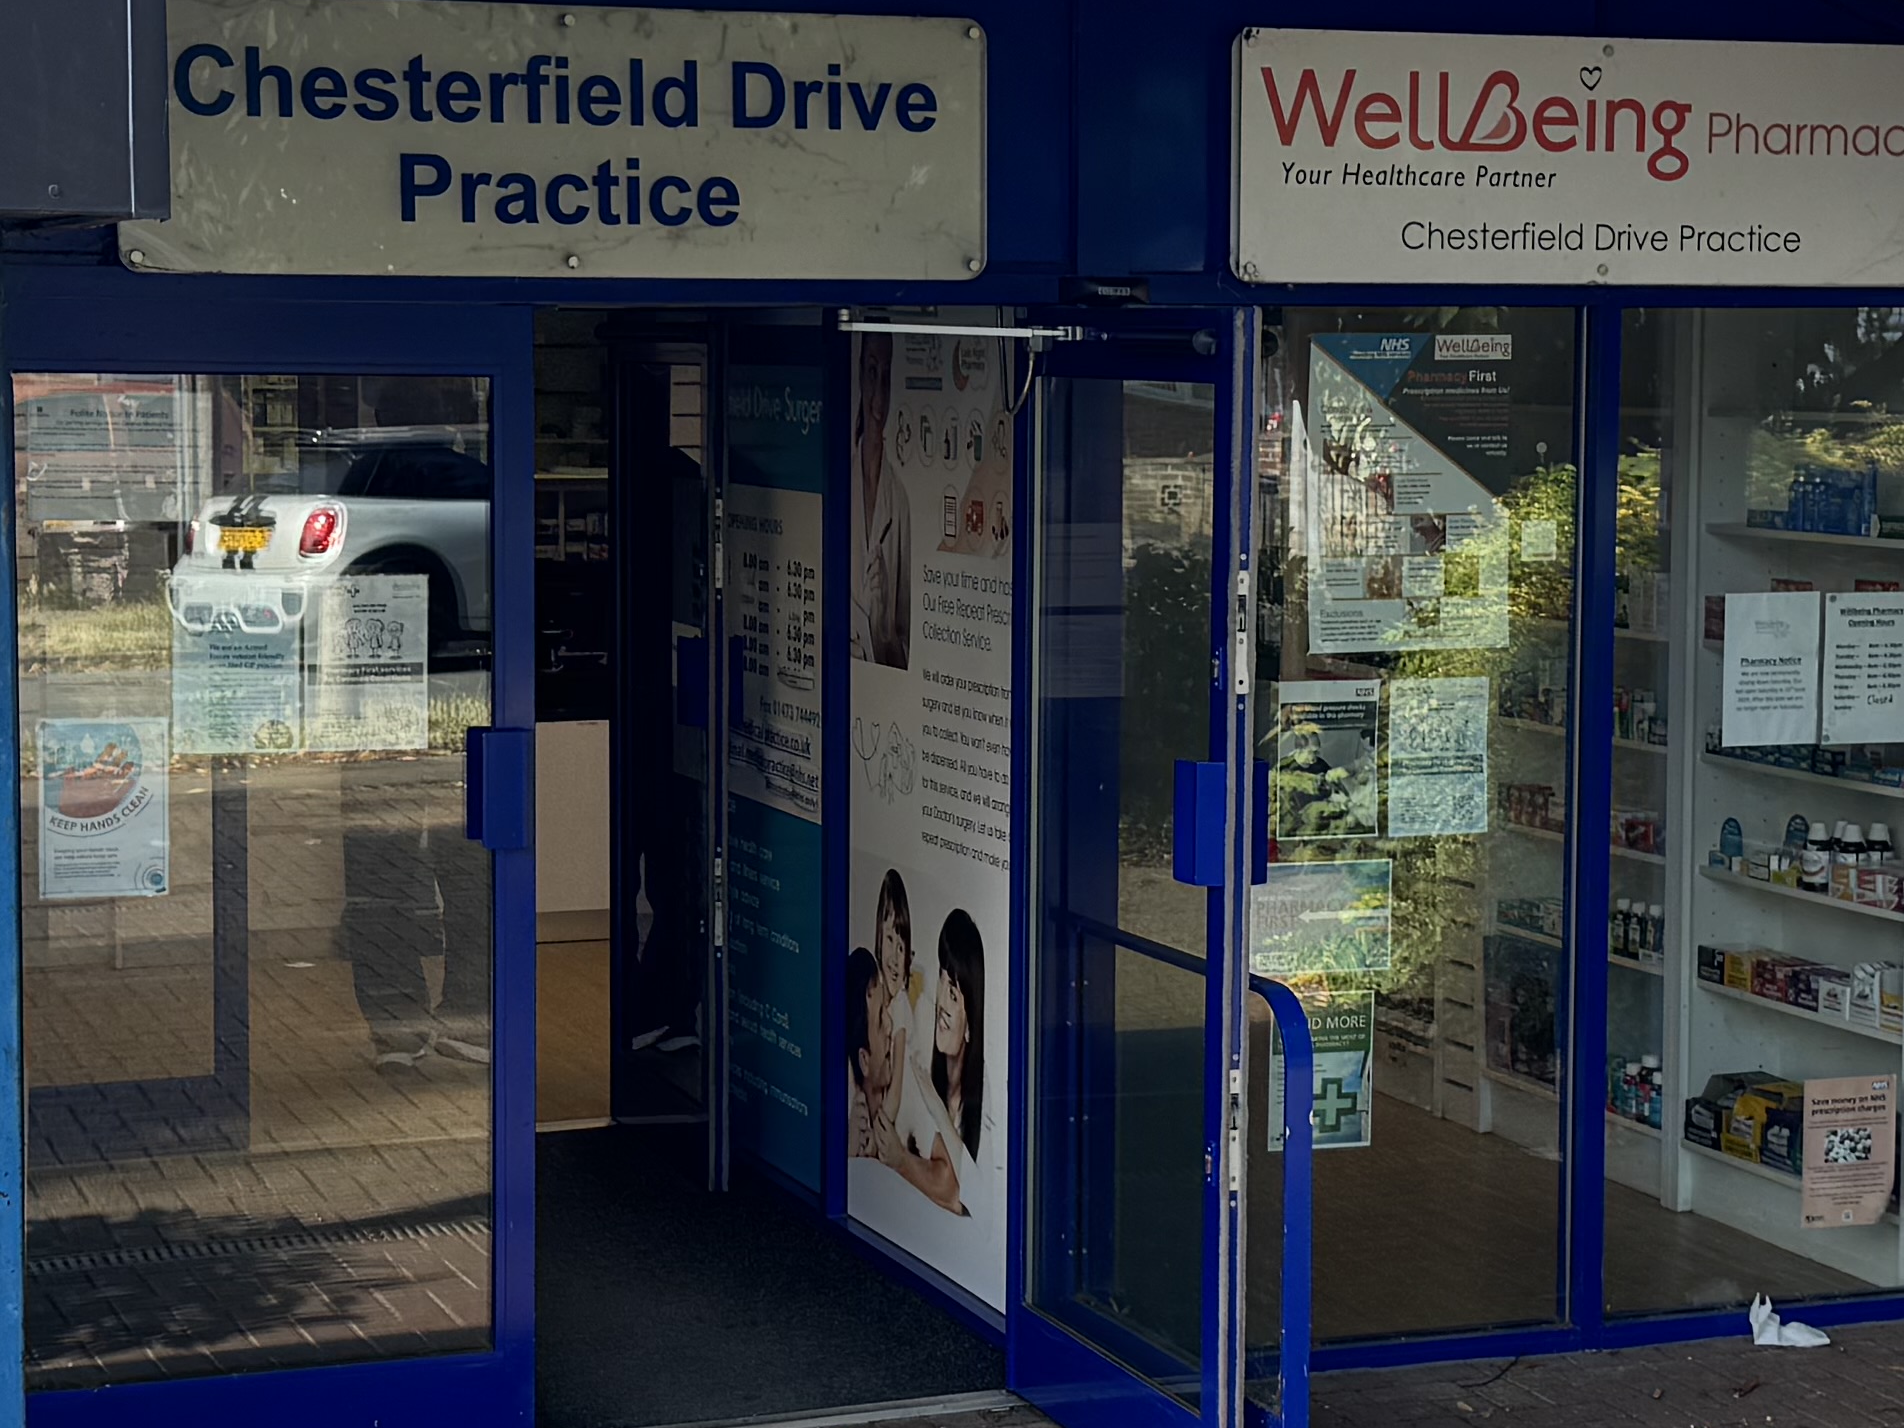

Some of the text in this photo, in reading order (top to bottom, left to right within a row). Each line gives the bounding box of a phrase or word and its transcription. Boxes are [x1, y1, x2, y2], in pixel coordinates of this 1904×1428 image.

[173, 43, 938, 133] Chesterfield Drive
[1261, 66, 1692, 181] WellBeing
[399, 152, 741, 227] Practice
[1281, 162, 1557, 188] Your Healthcare Partner
[1401, 221, 1802, 253] Chesterfield Drive Practice
[1380, 338, 1411, 352] NHS
[784, 386, 823, 435] Surger
[923, 564, 941, 584] Save
[943, 571, 959, 589] your
[961, 570, 978, 590] time
[980, 575, 997, 594] and
[923, 592, 936, 611] Our
[938, 595, 954, 615] Free
[957, 598, 984, 621] Repeat
[923, 621, 961, 645] Collection
[49, 786, 149, 832] KEEP HANDS CLEAN
[1326, 1014, 1367, 1029] MORE
